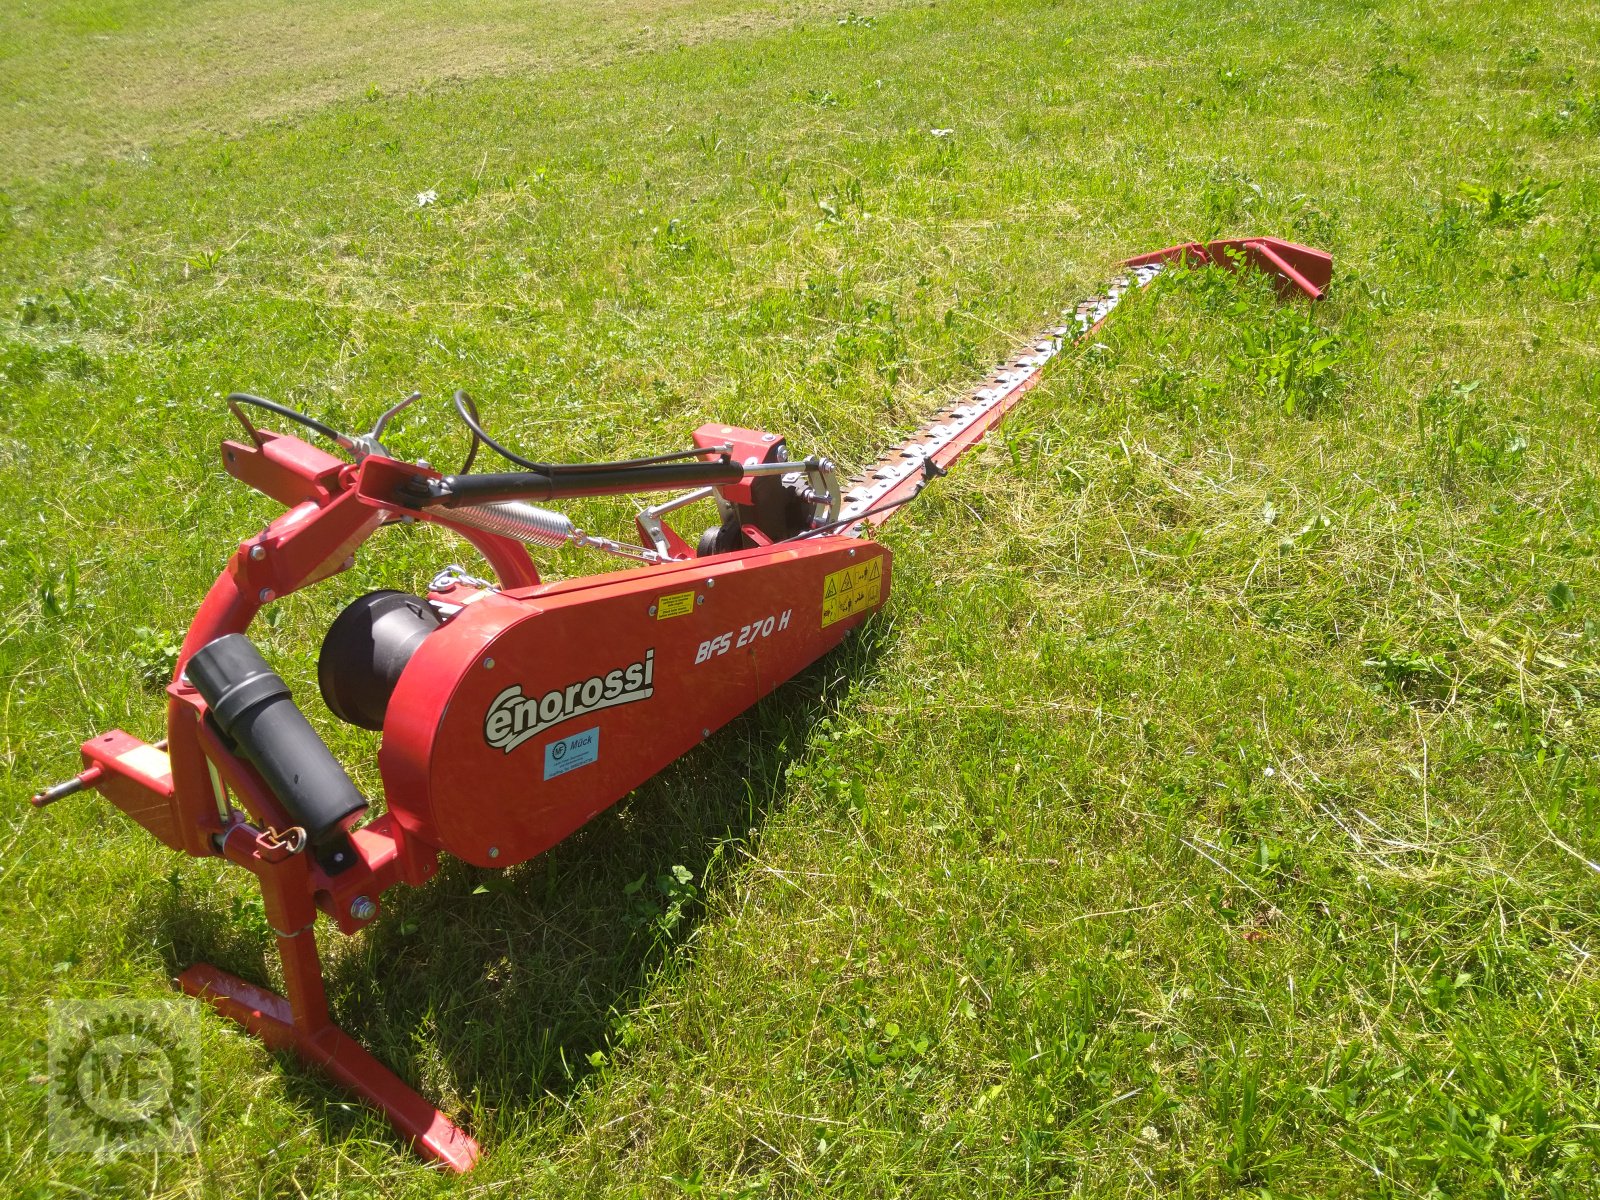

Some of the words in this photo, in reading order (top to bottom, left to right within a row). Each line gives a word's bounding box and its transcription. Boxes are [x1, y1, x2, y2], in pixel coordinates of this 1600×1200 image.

[695, 632, 733, 665] BFS
[736, 615, 775, 649] 270
[778, 608, 792, 632] H
[485, 648, 655, 753] enorossi
